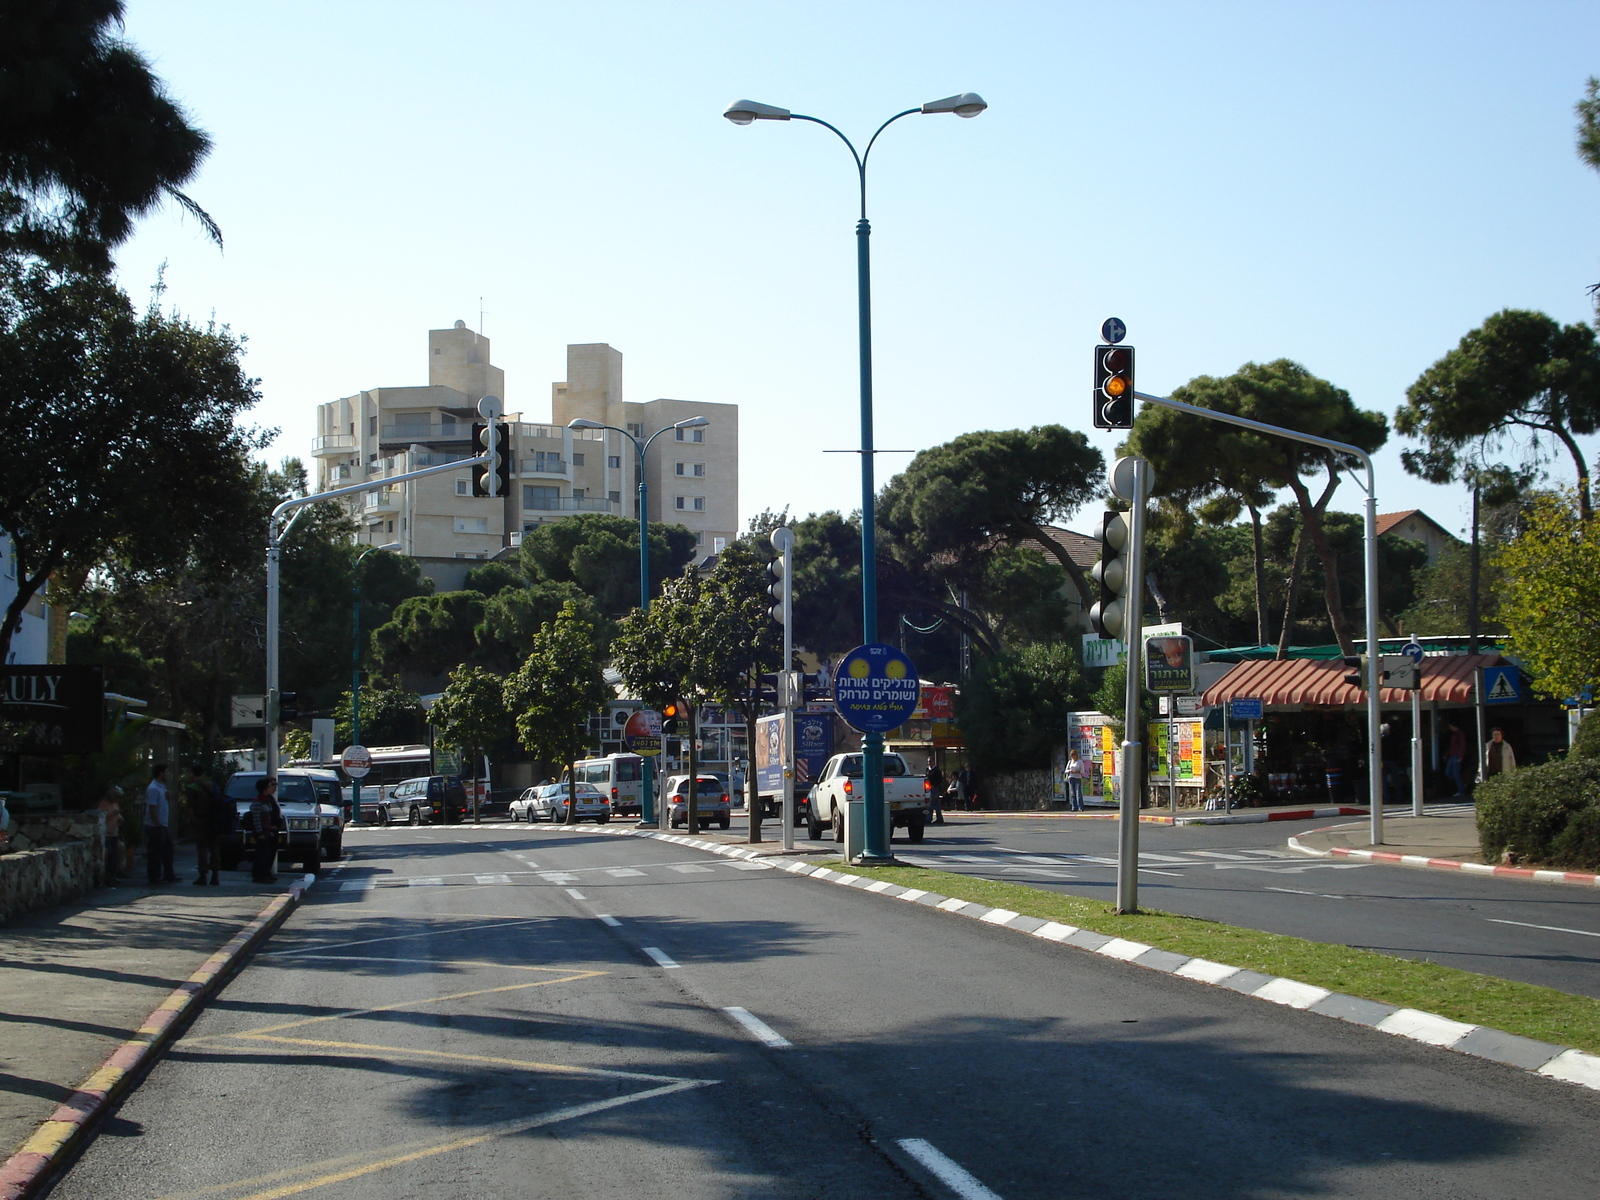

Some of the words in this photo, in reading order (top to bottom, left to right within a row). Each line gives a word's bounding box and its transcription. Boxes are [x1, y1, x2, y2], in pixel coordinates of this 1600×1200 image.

[1150, 669, 1189, 679] ארתור
[838, 677, 868, 688] אורות
[871, 676, 916, 690] מדליקים
[838, 689, 870, 701] מרחק
[873, 690, 916, 701] ושומרים
